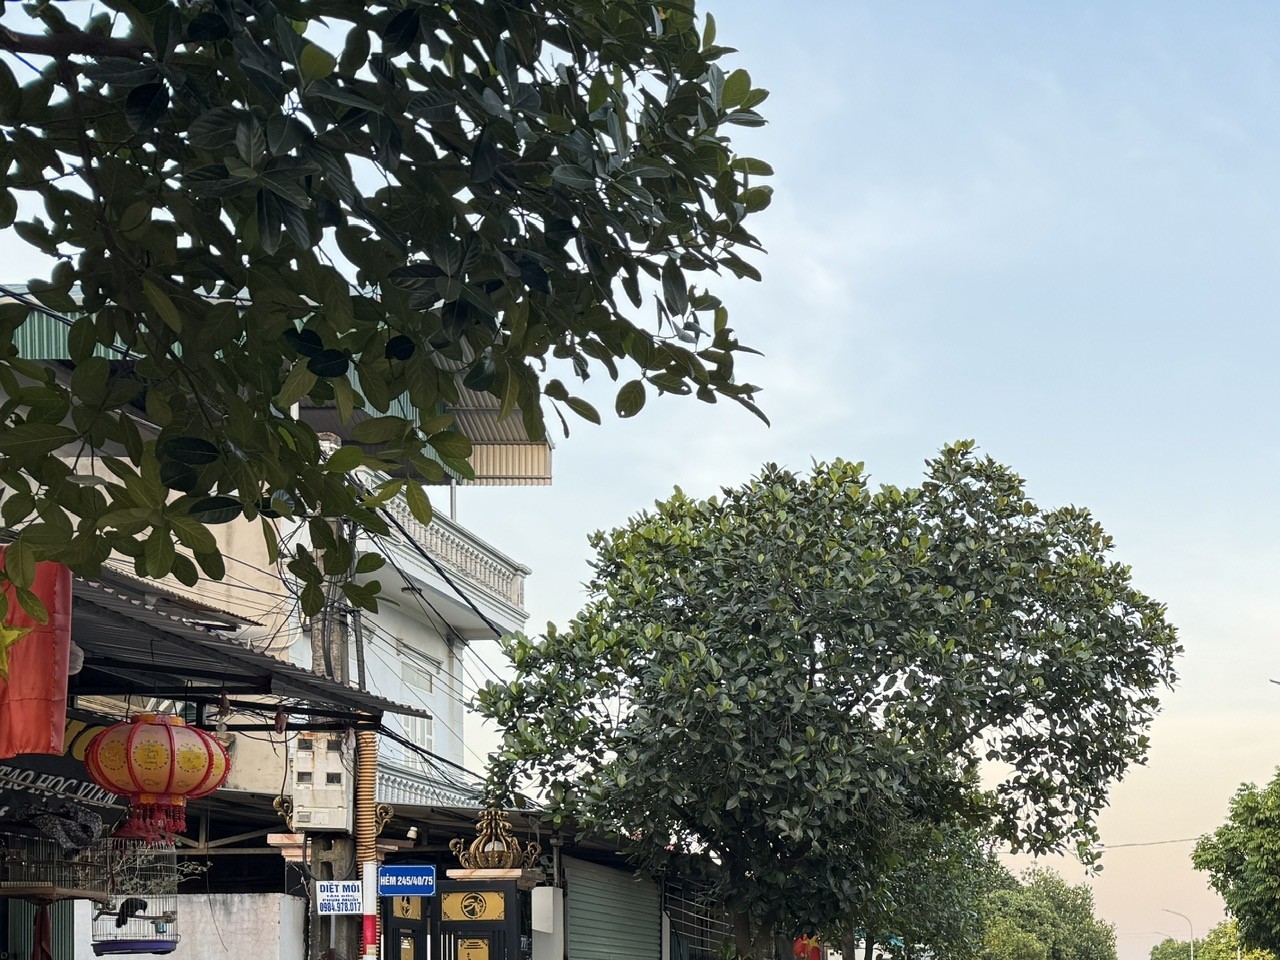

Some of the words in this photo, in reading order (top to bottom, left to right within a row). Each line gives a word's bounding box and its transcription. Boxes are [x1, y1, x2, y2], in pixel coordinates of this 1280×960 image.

[397, 875, 433, 886] 245/40/75
[319, 882, 340, 894] DIỆT
[319, 901, 361, 912] 0984.978.017
